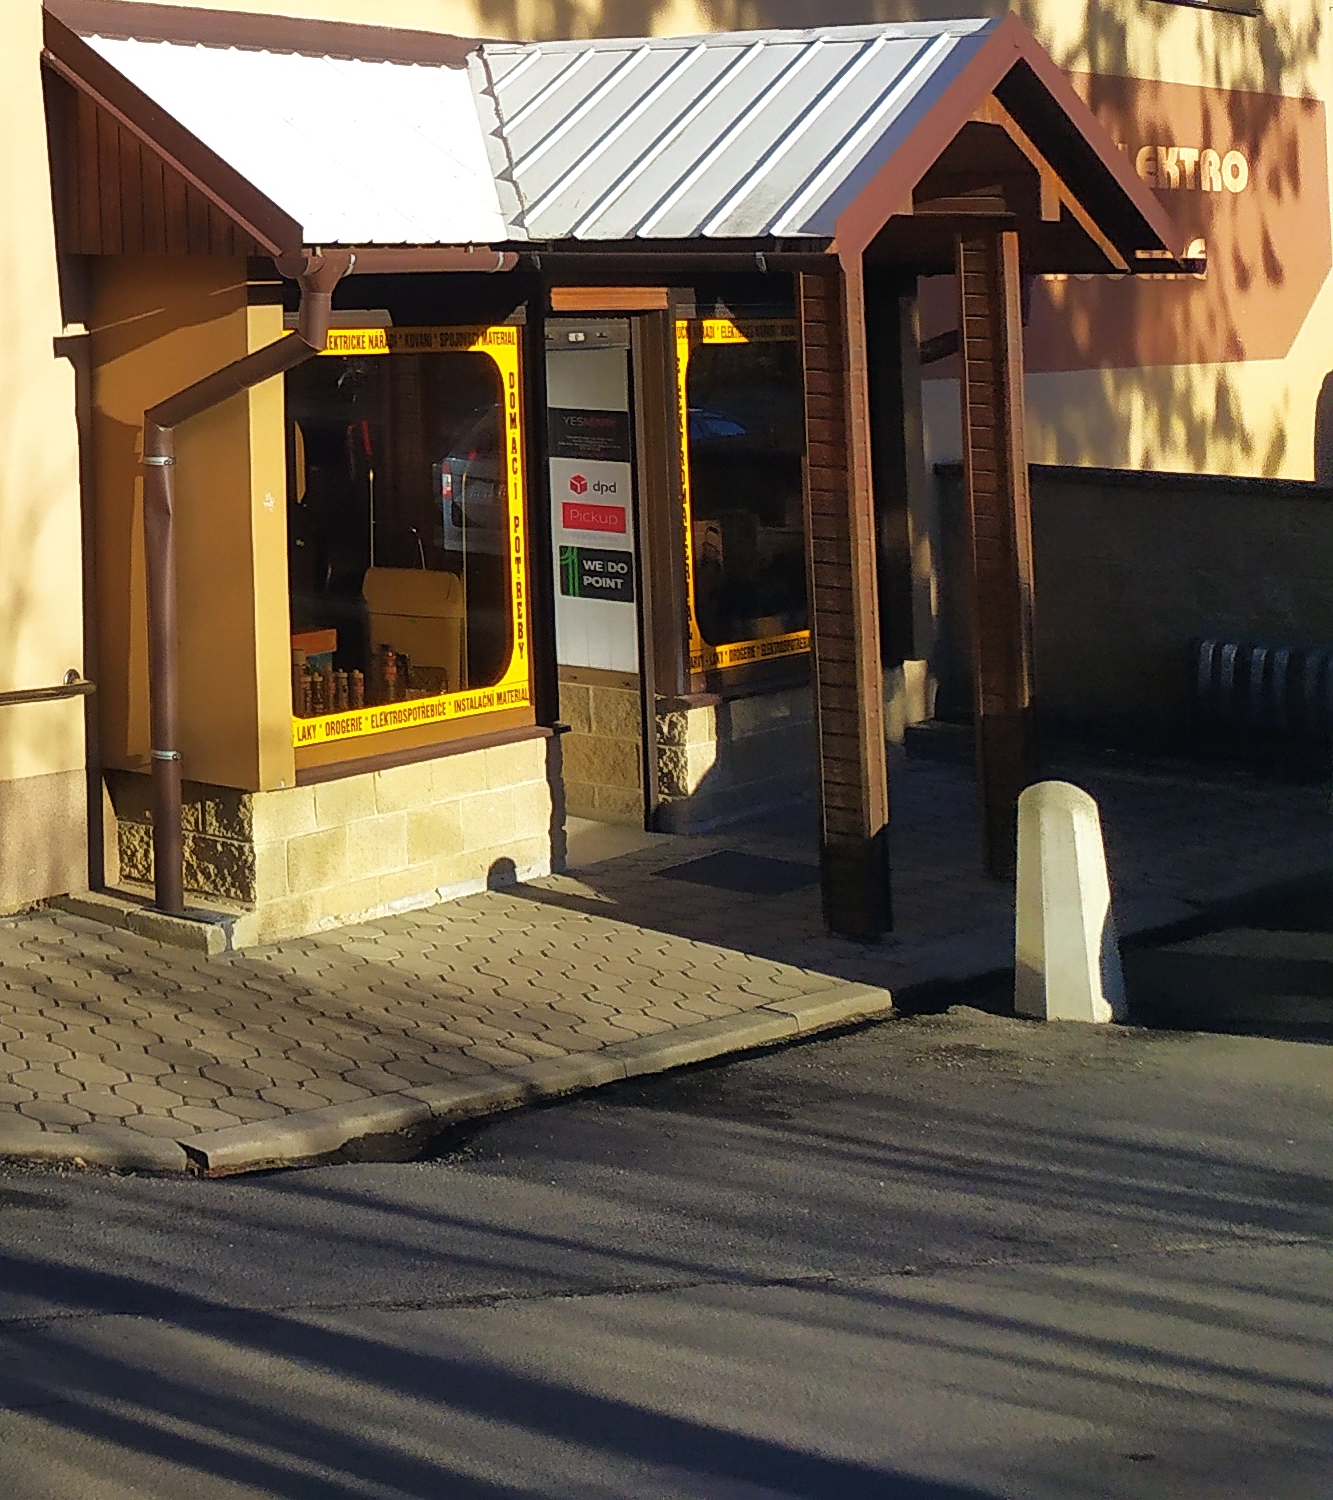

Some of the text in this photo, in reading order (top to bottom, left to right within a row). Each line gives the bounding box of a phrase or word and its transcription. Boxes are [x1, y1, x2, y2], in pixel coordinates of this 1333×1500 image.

[1118, 143, 1249, 193] EKTRO
[592, 480, 617, 495] dpd
[569, 508, 619, 526] Pickup
[582, 575, 624, 590] POINT
[296, 723, 317, 742] LAKY
[325, 716, 363, 737] DROGERIE
[370, 701, 447, 730] ELEKTROSPOTŘEBIČE
[454, 690, 495, 714] INSTALAČNÍ
